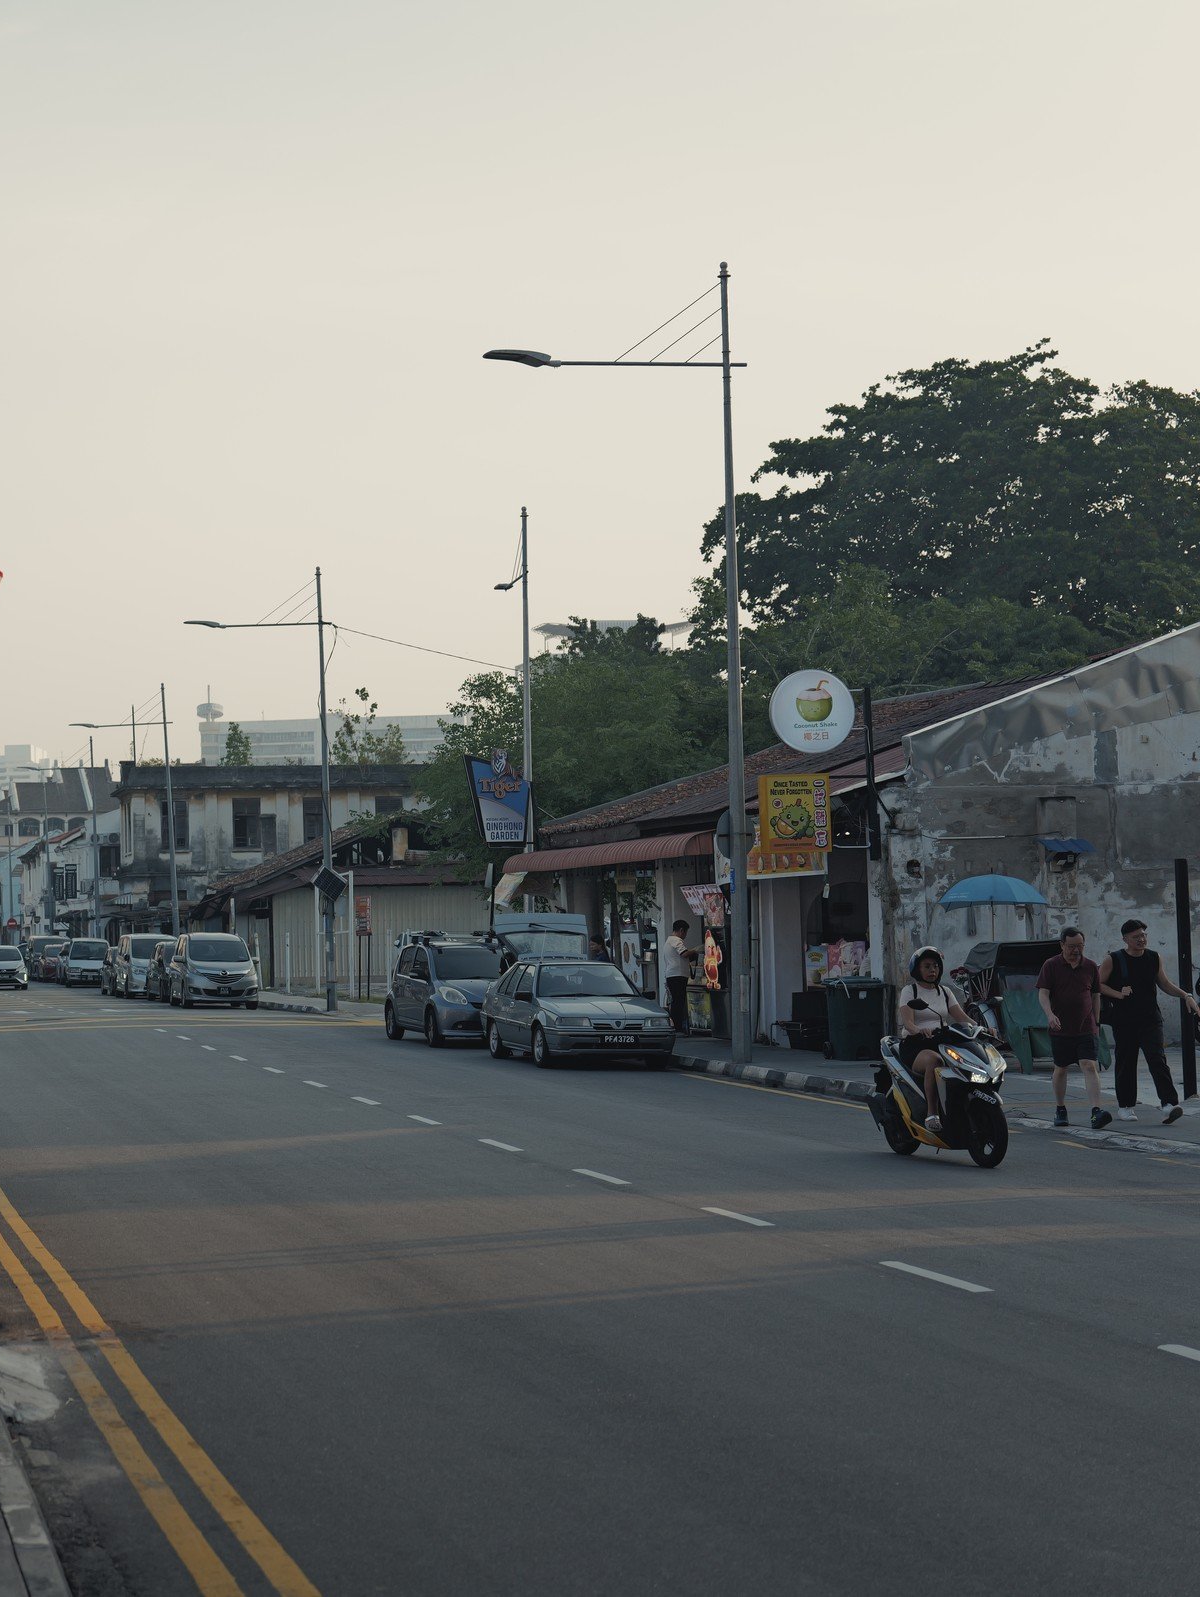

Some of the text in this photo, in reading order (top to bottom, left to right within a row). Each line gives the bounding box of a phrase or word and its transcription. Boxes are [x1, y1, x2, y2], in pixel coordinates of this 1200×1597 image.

[789, 780, 808, 788] TASTED
[480, 779, 523, 799] Tiger
[770, 788, 812, 796] NEVER FORGOTTEN
[486, 822, 523, 831] QINGHONG
[490, 831, 519, 840] GARDEN
